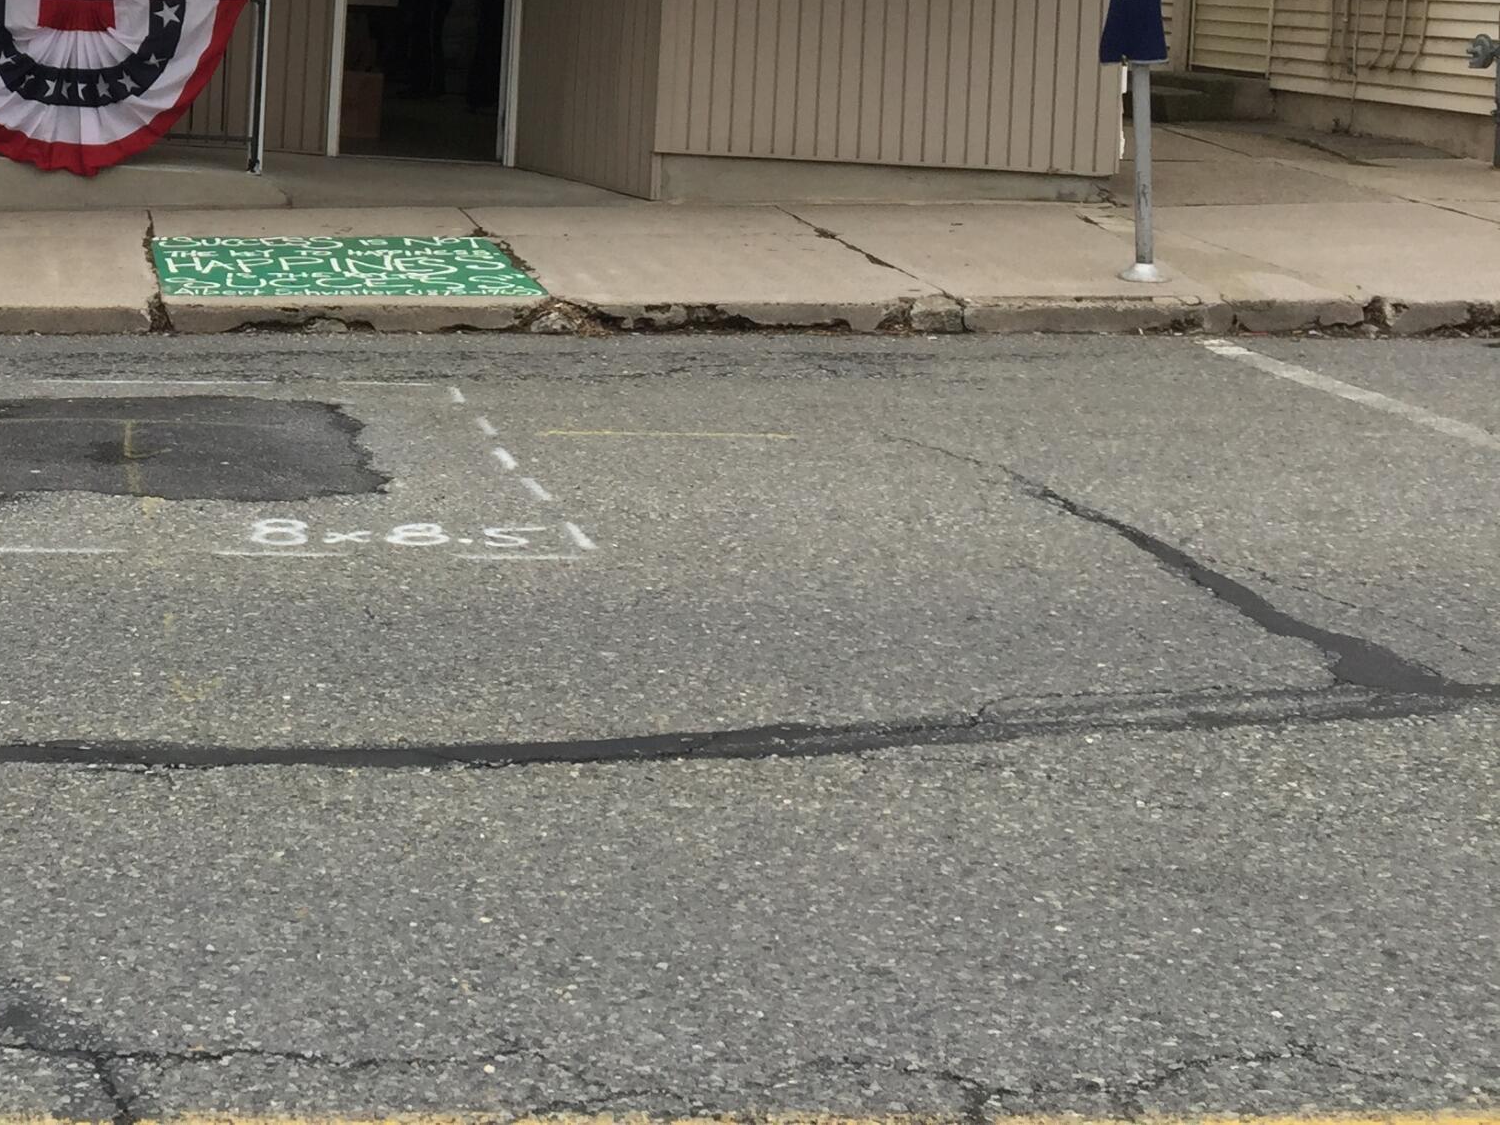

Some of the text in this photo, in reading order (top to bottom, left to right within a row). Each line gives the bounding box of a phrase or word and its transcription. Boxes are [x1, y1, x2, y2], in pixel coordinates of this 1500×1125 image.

[403, 236, 484, 249] NOT
[229, 249, 274, 257] KEY
[164, 256, 505, 277] HAPPINESS
[174, 287, 263, 296] Albert
